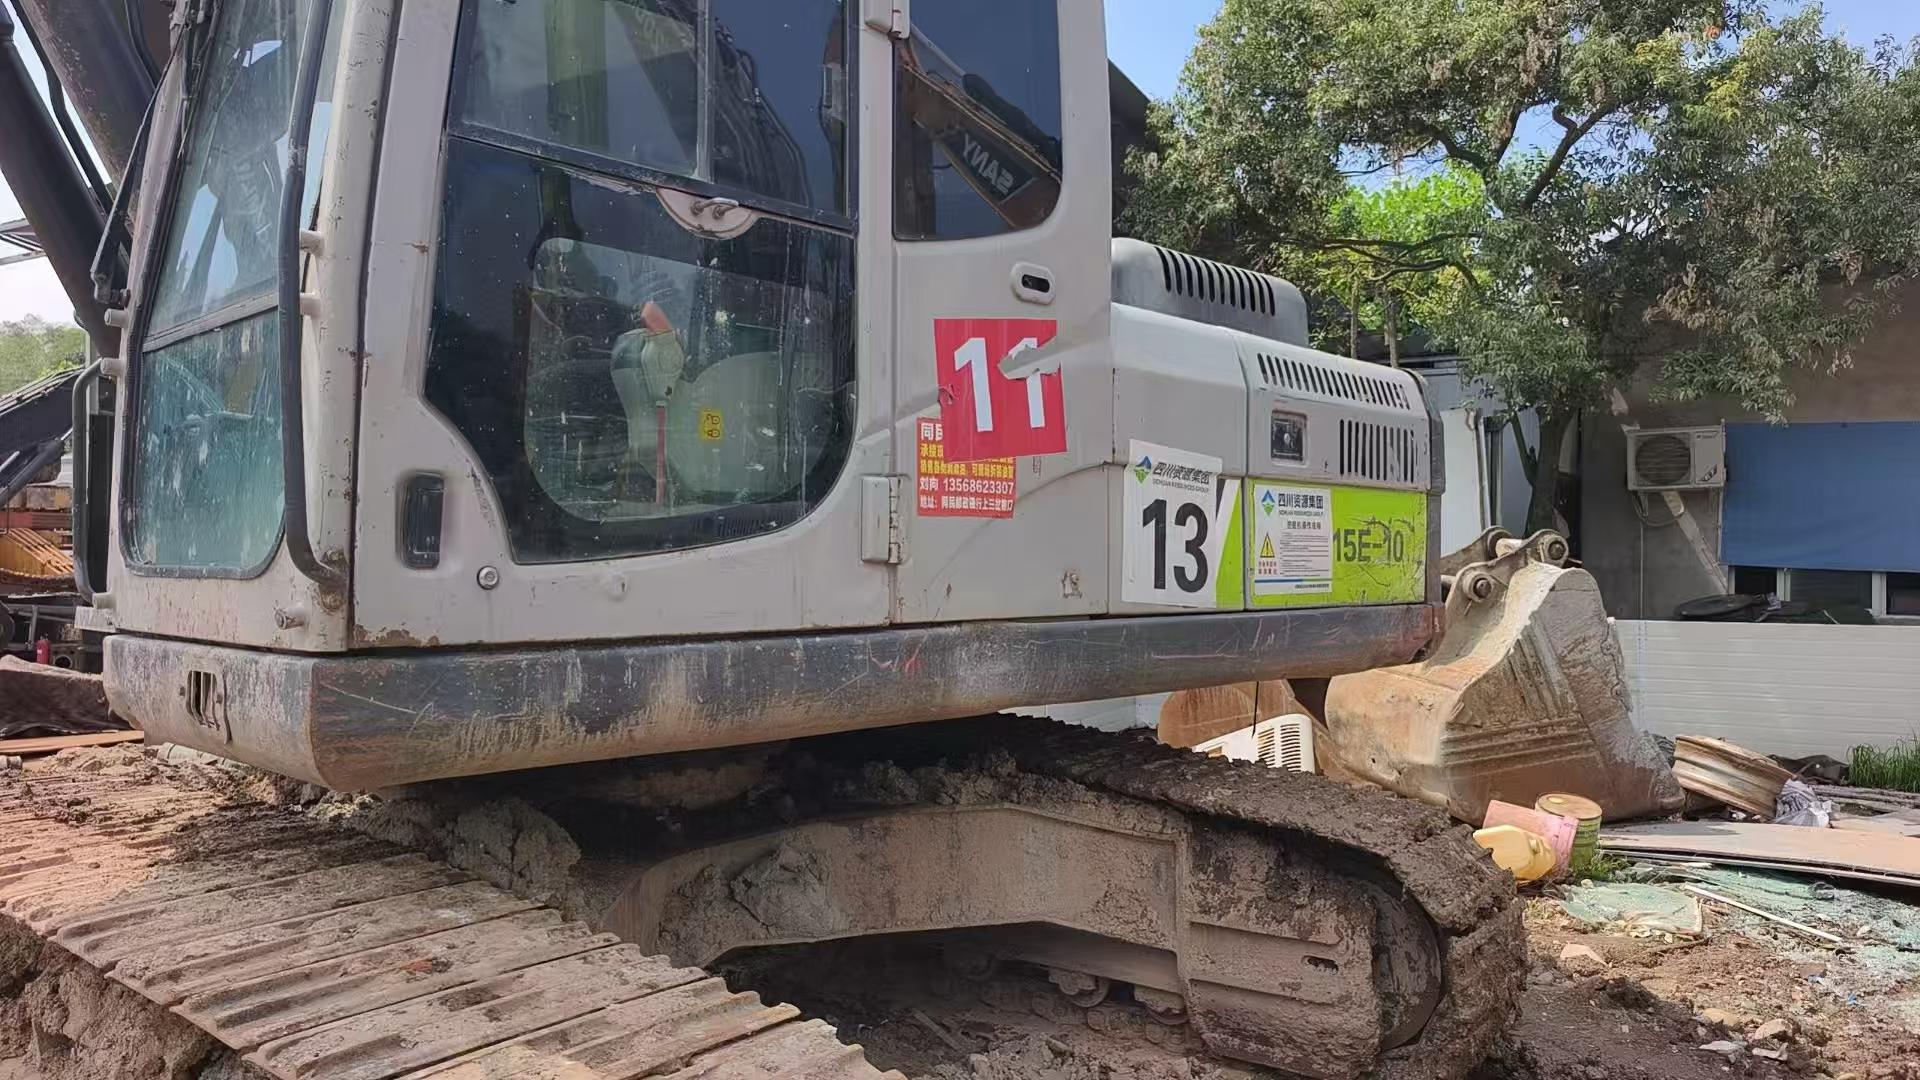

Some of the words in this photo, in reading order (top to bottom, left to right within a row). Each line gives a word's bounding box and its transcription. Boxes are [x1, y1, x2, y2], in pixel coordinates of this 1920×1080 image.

[1153, 462, 1213, 485] 四川资源集团
[943, 478, 1014, 494] 13568623307
[1278, 493, 1323, 509] 四川资源集团
[1143, 499, 1208, 592] 13
